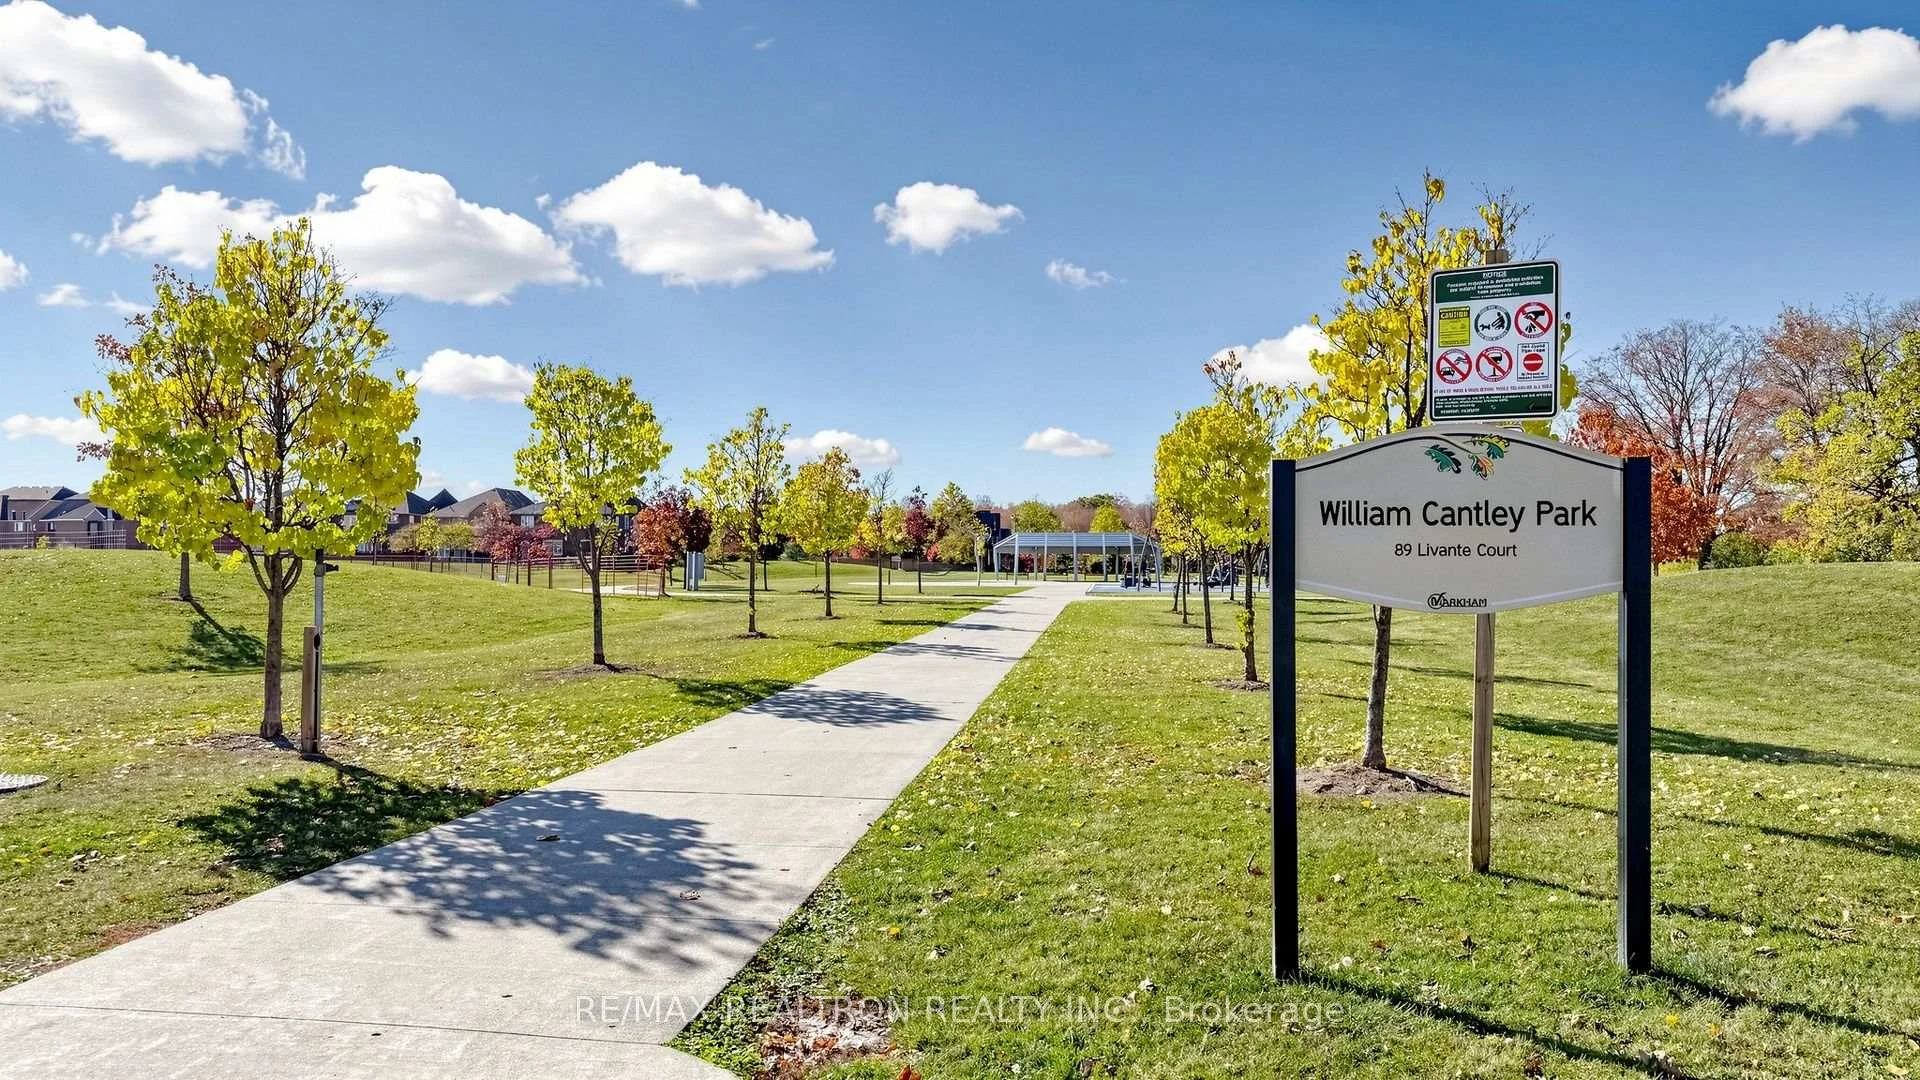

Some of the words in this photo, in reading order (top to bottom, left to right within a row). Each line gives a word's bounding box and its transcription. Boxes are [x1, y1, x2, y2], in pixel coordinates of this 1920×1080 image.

[1319, 500, 1411, 526] William
[1422, 499, 1526, 533] Cantley
[1536, 499, 1597, 526] Park
[1394, 543, 1412, 557] 89
[1417, 543, 1471, 557] Livante
[1477, 543, 1518, 557] Court
[1427, 592, 1487, 610] MARKHAM
